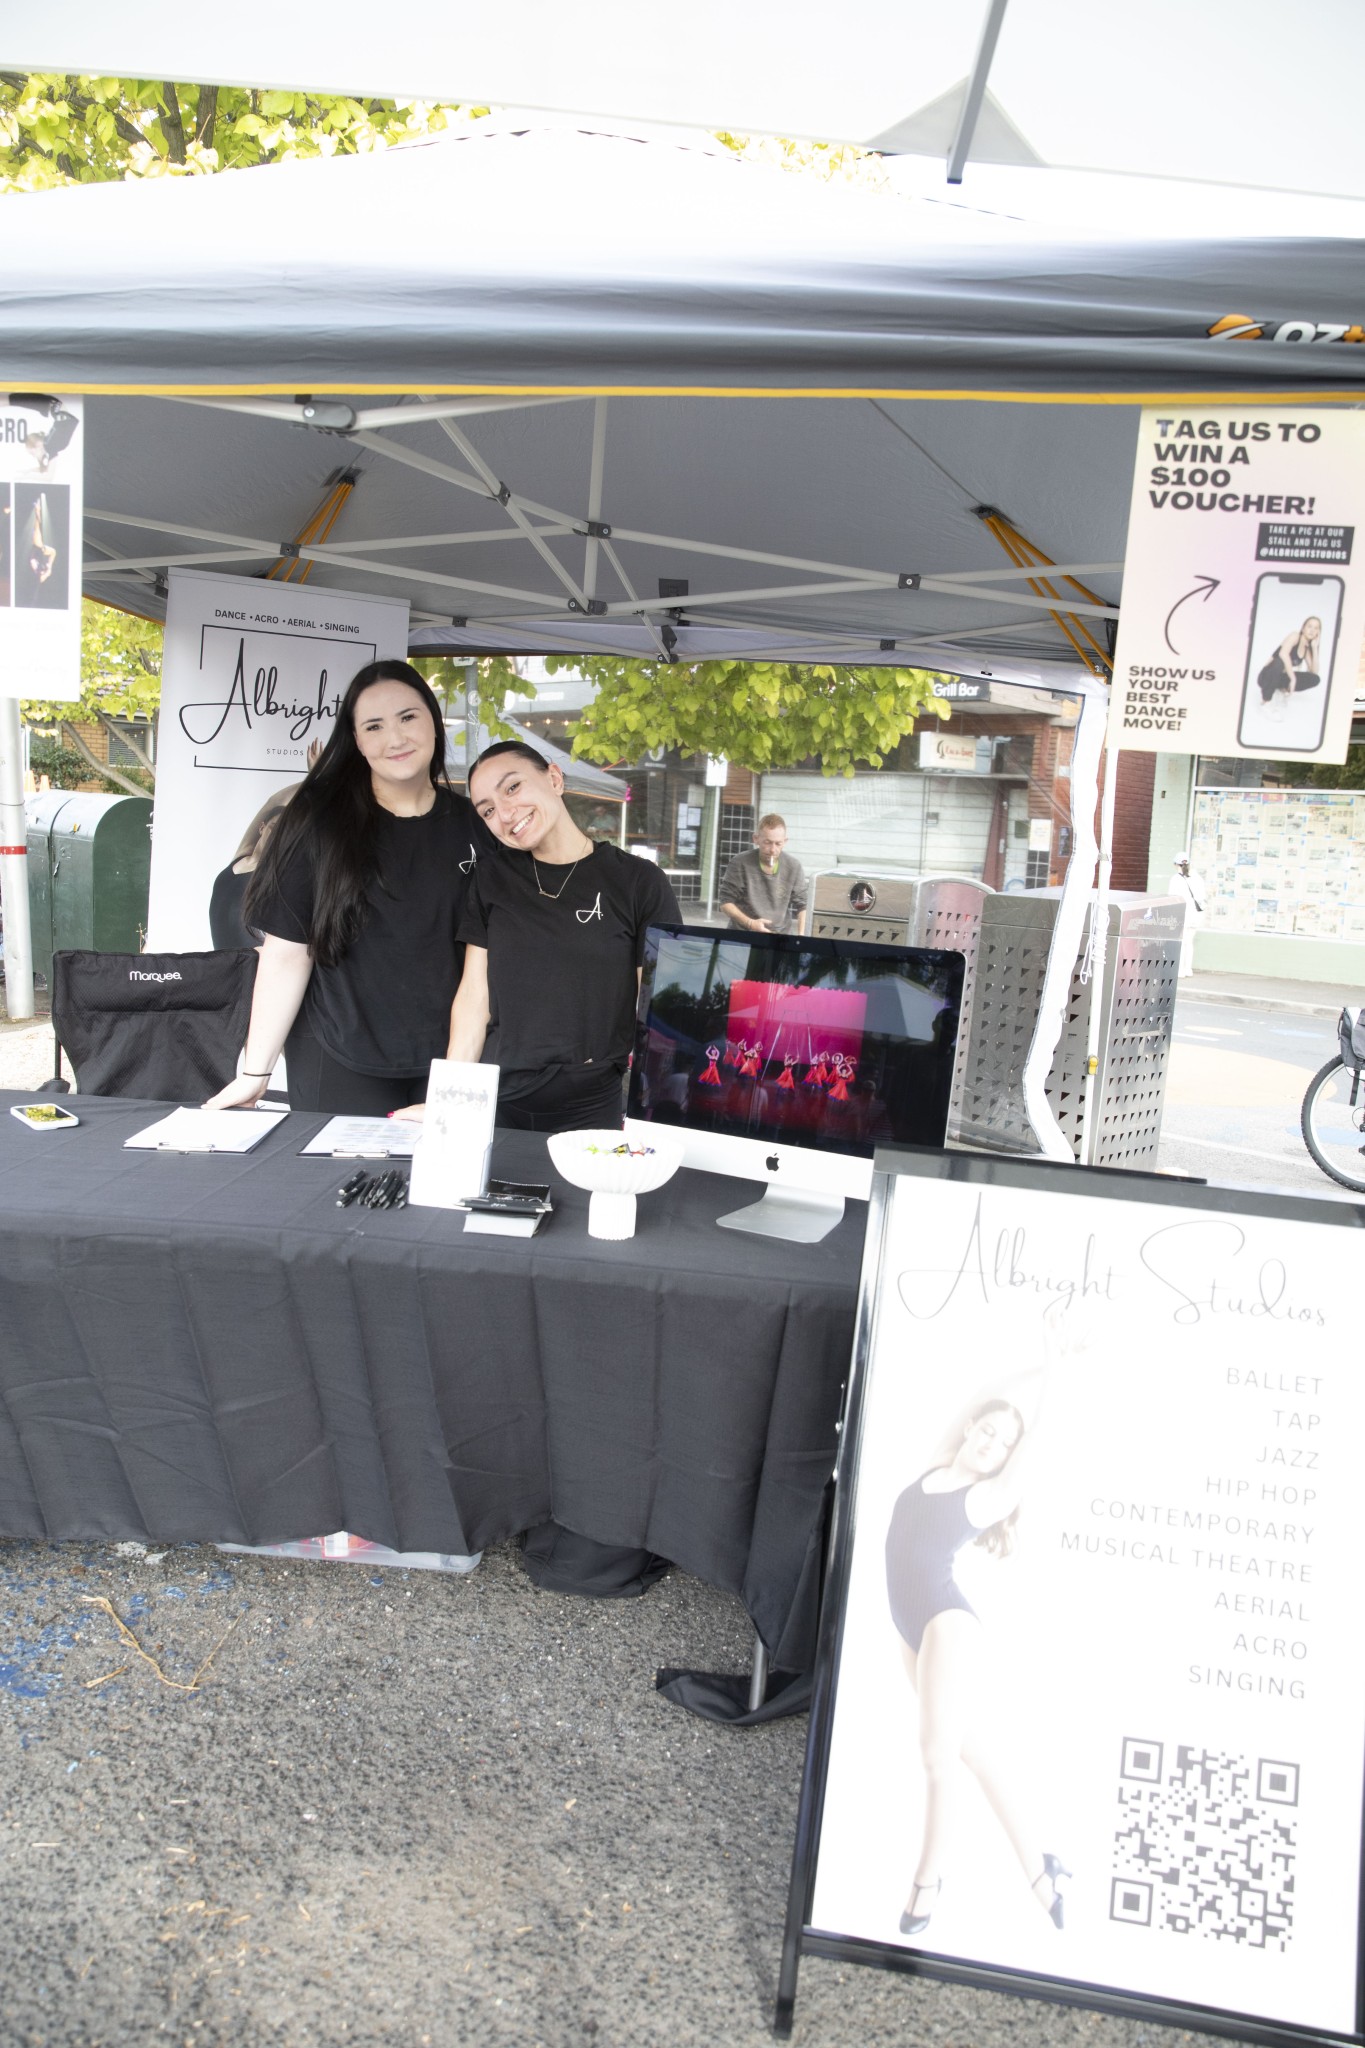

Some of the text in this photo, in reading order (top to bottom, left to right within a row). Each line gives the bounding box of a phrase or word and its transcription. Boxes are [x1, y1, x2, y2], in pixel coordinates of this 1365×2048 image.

[1156, 419, 1321, 443] TAG US TO
[1154, 443, 1250, 464] WIN A
[1150, 465, 1231, 487] $100
[1149, 490, 1315, 515] VOUCHER!
[1267, 536, 1342, 548] STALL AND TAG US
[1268, 525, 1345, 537] TAKE A PIC AT OUR
[214, 608, 361, 635] DANCE ACRO AERIAL SINGING
[1128, 665, 1217, 681] SHOW US
[1128, 678, 1179, 692] YOUR
[178, 637, 343, 745] Albright
[933, 682, 979, 697] Grill Bar
[1126, 691, 1171, 704] BEST
[1124, 704, 1188, 719] DANCE
[1123, 717, 1182, 731] MOVE!
[266, 747, 305, 757] STUDIOS
[897, 1191, 1326, 1326] Albright Studios
[1226, 1367, 1324, 1396] BALLET
[1272, 1409, 1321, 1432] TAP
[1256, 1446, 1320, 1470] JAZZ
[1205, 1475, 1317, 1507] HIP HOP
[1089, 1498, 1315, 1545] CONTEMPORARY
[1061, 1531, 1314, 1584] MUSICAL THEATRE
[1214, 1592, 1311, 1622] AERIAL
[1232, 1633, 1308, 1661] ACRO
[1188, 1664, 1306, 1700] SINGING
